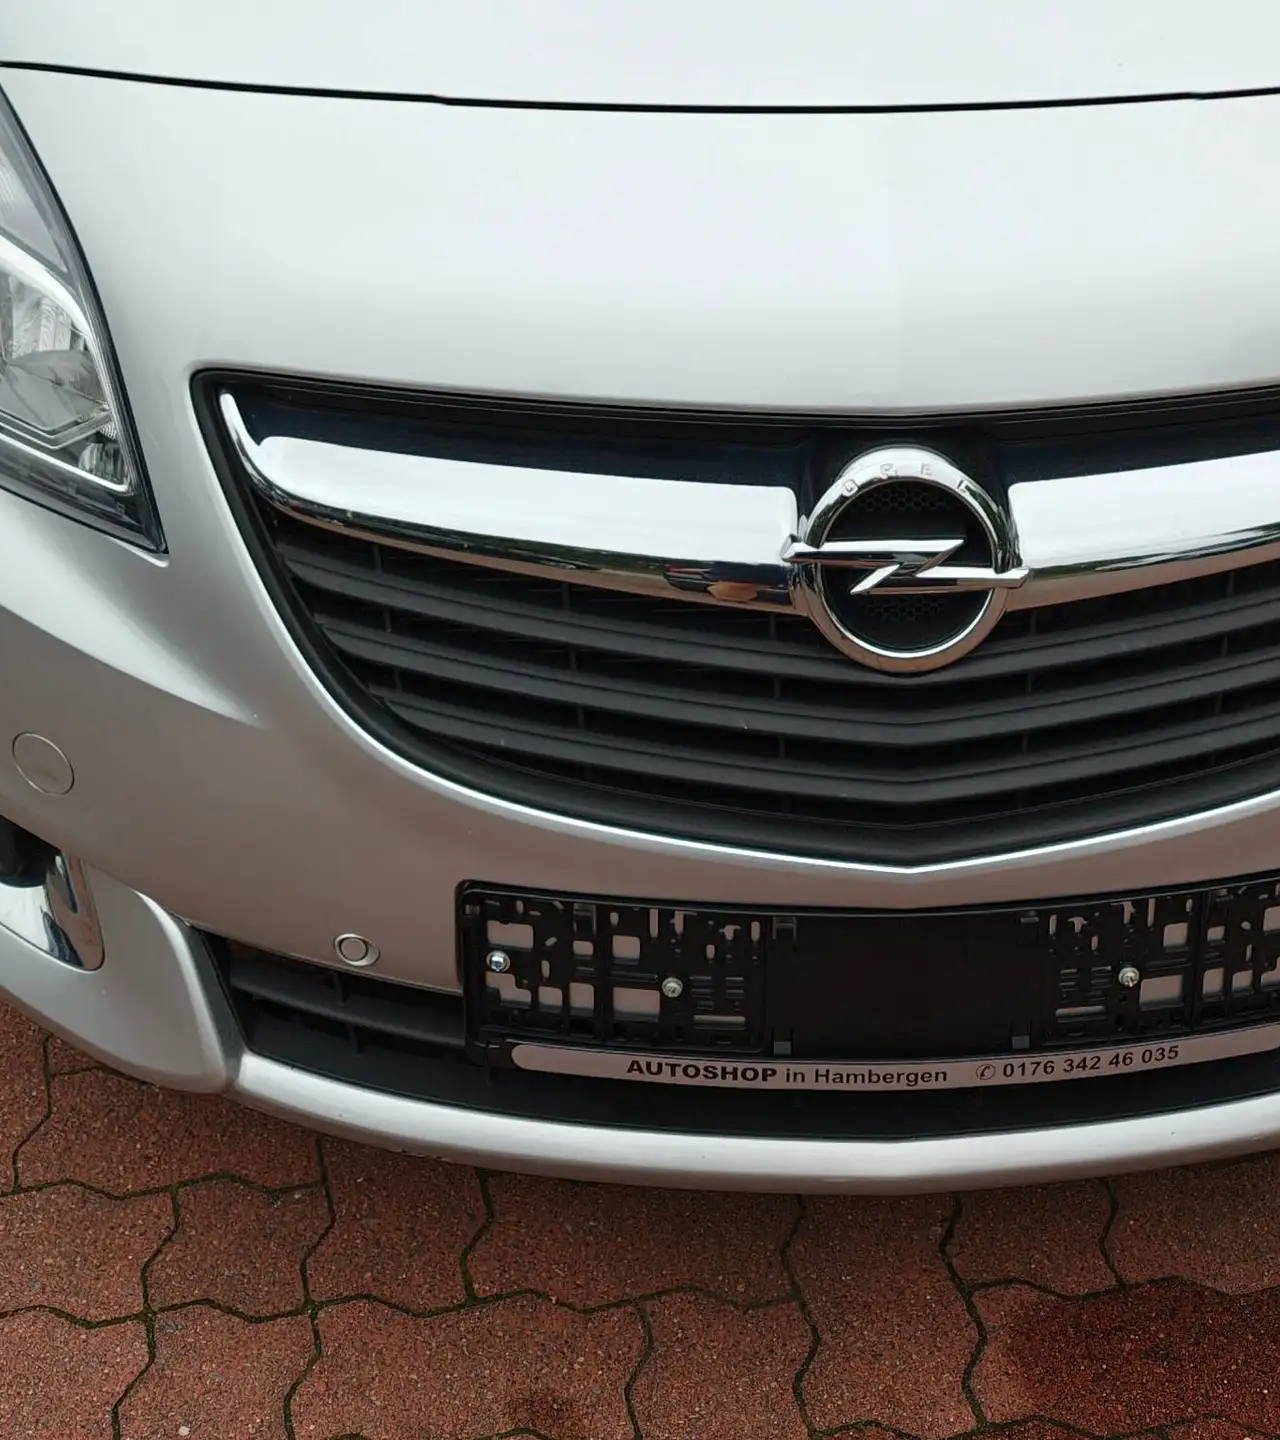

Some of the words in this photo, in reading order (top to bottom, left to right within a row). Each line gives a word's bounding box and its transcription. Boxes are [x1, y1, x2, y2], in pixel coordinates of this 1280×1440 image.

[627, 1059, 777, 1082] AUTOSHOP
[786, 1067, 806, 1083] in
[814, 1068, 948, 1086] Hambergen
[1002, 1059, 1056, 1080] 0176
[1062, 1055, 1102, 1073] 342
[1108, 1051, 1134, 1068] 46
[1141, 1044, 1180, 1063] 035
